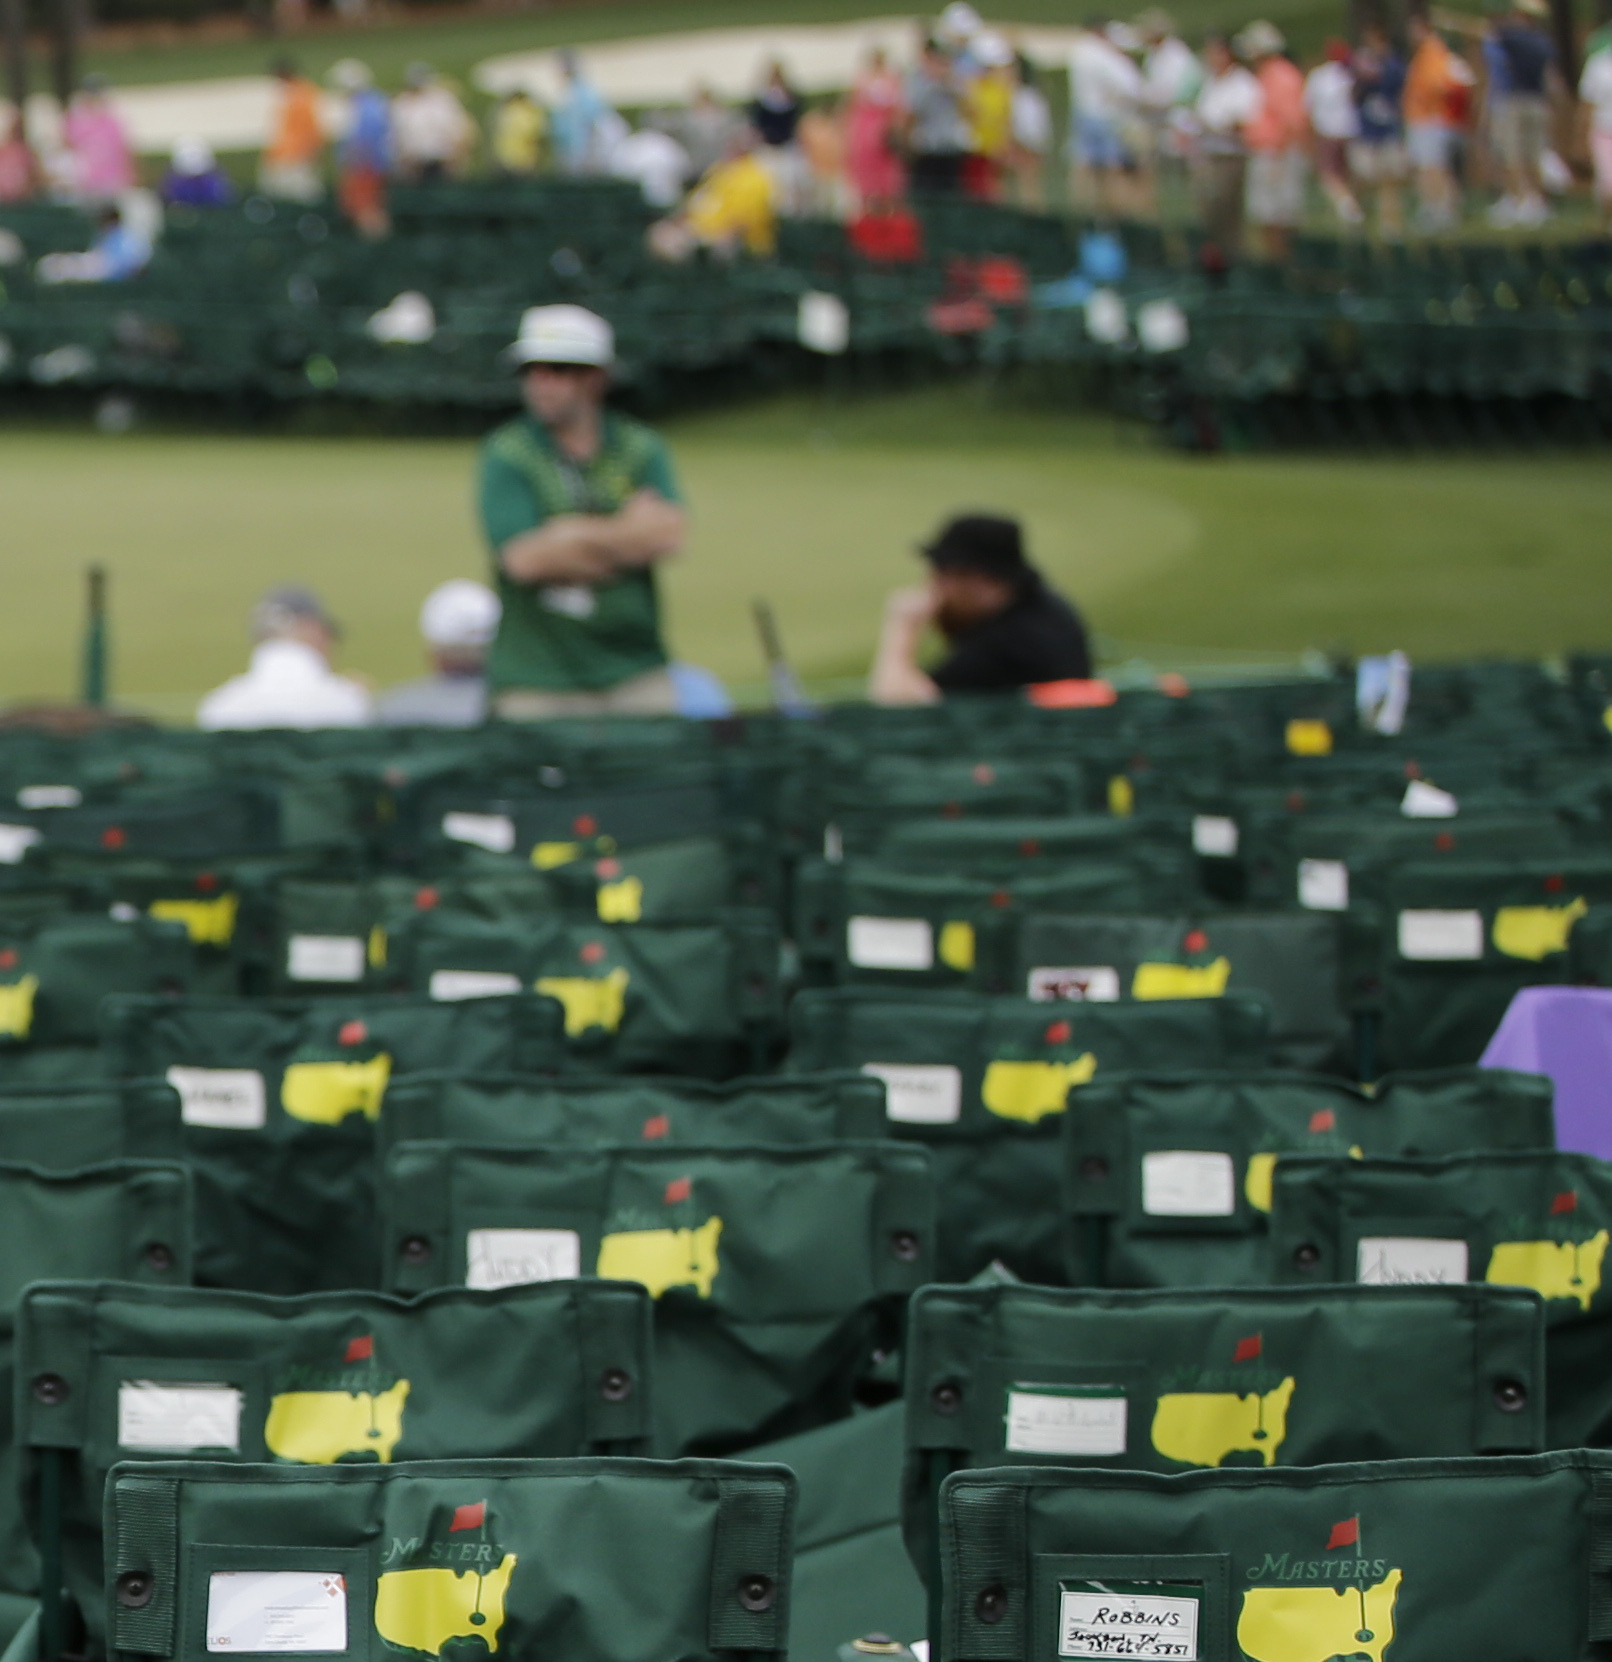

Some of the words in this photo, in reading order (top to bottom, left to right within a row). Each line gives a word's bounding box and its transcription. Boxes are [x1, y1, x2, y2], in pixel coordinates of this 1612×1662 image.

[383, 1537, 504, 1564] MSTERS
[1246, 1553, 1387, 1582] MASTERS
[1091, 1607, 1180, 1626] ROBBINS
